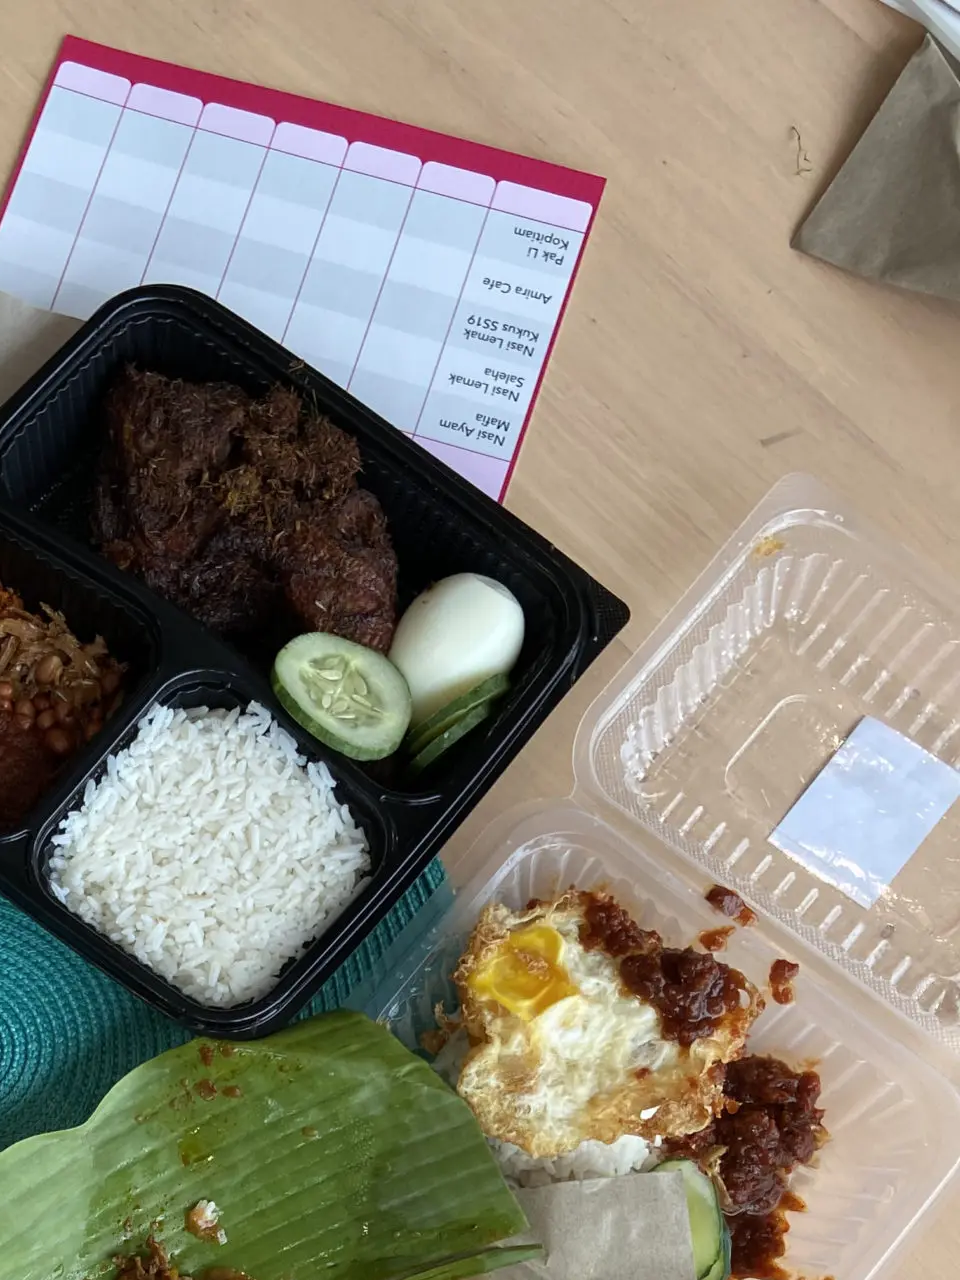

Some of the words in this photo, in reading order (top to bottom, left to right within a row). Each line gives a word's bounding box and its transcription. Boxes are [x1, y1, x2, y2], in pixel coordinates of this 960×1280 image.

[514, 226, 570, 250] Kopitiam
[526, 246, 539, 259] Li
[542, 251, 565, 266] Pak
[482, 277, 512, 294] Cafe
[515, 286, 553, 305] Amira
[467, 315, 499, 331] SS19
[463, 327, 503, 348] Lemak
[502, 323, 540, 343] Kukus
[507, 341, 535, 358] Nasi
[448, 372, 489, 394] Lemak
[484, 367, 525, 388] Saleha
[492, 385, 520, 402] Nasi
[439, 418, 475, 438] Ayam
[475, 413, 511, 432] Mafia
[477, 430, 506, 447] Nasi
